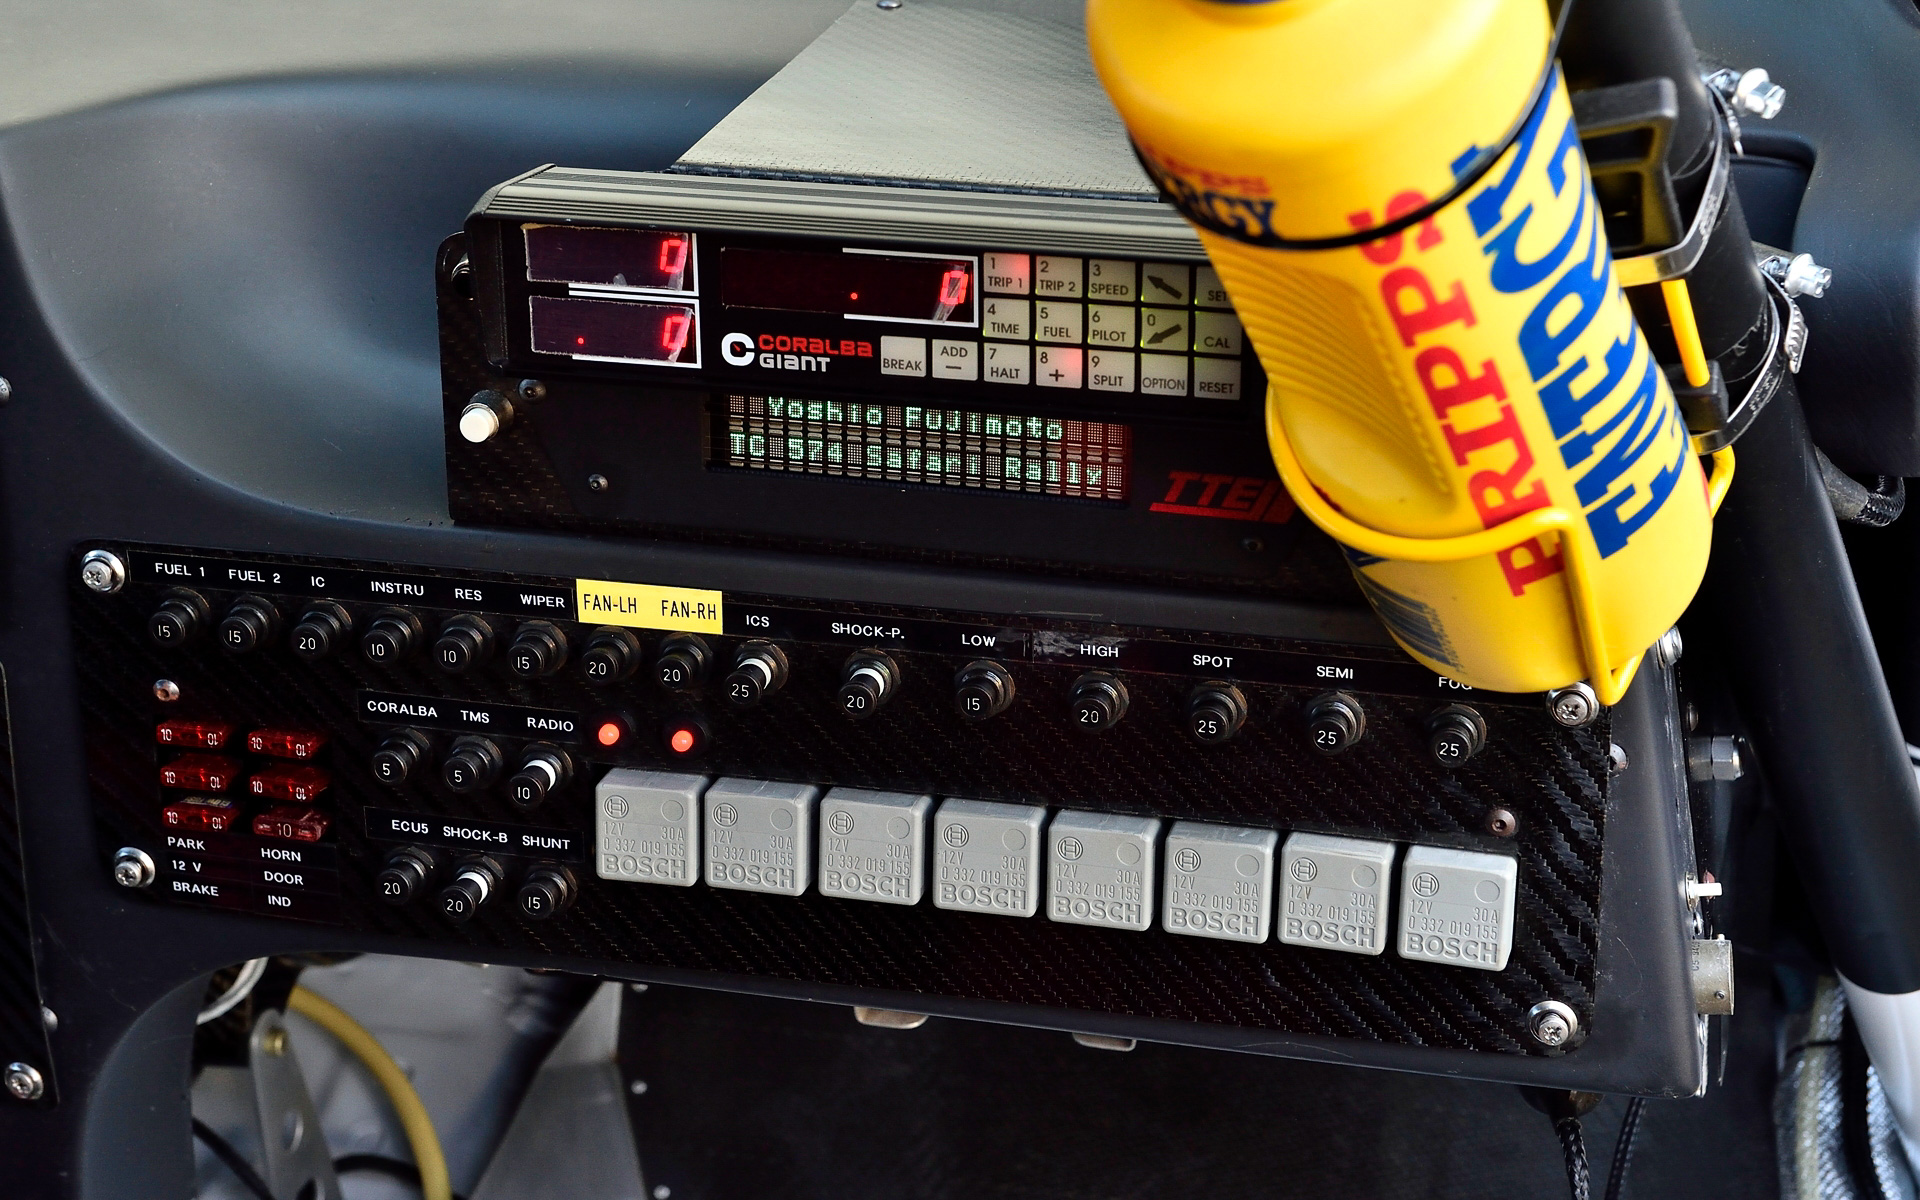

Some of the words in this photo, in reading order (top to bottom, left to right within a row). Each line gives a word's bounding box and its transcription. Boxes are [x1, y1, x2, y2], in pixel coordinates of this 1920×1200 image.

[660, 240, 685, 272] 0
[990, 257, 995, 269] 1
[1040, 261, 1049, 272] 2
[1093, 264, 1101, 276] 3
[988, 276, 1013, 288] TRIP
[1018, 278, 1022, 289] 1
[1040, 279, 1066, 291] TRIP
[1068, 281, 1076, 292] 2
[1091, 283, 1129, 296] SPEED
[1208, 290, 1228, 301] SET
[987, 304, 996, 316] 4
[1040, 308, 1048, 319] 5
[1092, 311, 1100, 323] 6
[1147, 314, 1156, 326] 0
[991, 322, 1020, 334] TIME
[1044, 326, 1071, 338] FUEL
[1092, 330, 1126, 342] PILOT
[1204, 336, 1230, 349] CAL
[759, 334, 873, 357] CORALBA
[940, 346, 968, 358] ADD
[989, 348, 997, 360] 7
[1040, 352, 1048, 364] 8
[759, 353, 830, 372] GIANT
[882, 358, 922, 372] BREAK
[1092, 356, 1100, 368] 9
[991, 367, 1020, 379] HALT
[1094, 374, 1124, 387] SPLIT
[1142, 377, 1186, 390] OPTION
[1200, 382, 1234, 394] RESET
[1347, 189, 1564, 597] PRIPPS
[768, 396, 882, 425] Yoshio
[906, 406, 1062, 440] Fujimoto
[788, 438, 843, 463] 574
[866, 444, 976, 475] Safari
[1005, 456, 1102, 486] Rally
[155, 562, 191, 576] FUEL
[200, 567, 204, 576] 1
[228, 570, 265, 582] FUEL
[273, 573, 281, 584] 2
[311, 576, 325, 588] IC
[370, 581, 424, 596] INSTRU
[454, 588, 482, 602] RES
[520, 594, 566, 608] WIPER
[584, 594, 637, 614] FAN-LH
[661, 600, 717, 620] FAN-RH
[746, 614, 770, 628] ICS
[158, 624, 170, 638] 15
[228, 630, 241, 643] 15
[831, 622, 905, 640] SHOCK-P.
[300, 638, 316, 650] 20
[961, 634, 996, 648] LOW
[372, 644, 384, 656] 10
[443, 650, 456, 663] 10
[1080, 644, 1119, 658] HIGH
[517, 656, 530, 670] 15
[1192, 654, 1233, 668] SPOT
[589, 662, 607, 676] 20
[663, 668, 681, 682] 20
[1316, 666, 1354, 680] SEMI
[732, 684, 750, 698] 25
[367, 700, 438, 718] CORALBA
[846, 696, 865, 710] 20
[966, 698, 980, 712] 15
[460, 710, 490, 724] TMS
[1080, 710, 1099, 724] 20
[527, 718, 574, 732] RADIO
[1198, 720, 1217, 734] 25
[160, 728, 172, 741] 10
[1318, 730, 1336, 744] 25
[252, 737, 262, 750] 10
[1440, 742, 1460, 757] 25
[382, 764, 390, 776] 5
[454, 770, 462, 782] 5
[164, 772, 176, 784] 10
[252, 781, 262, 793] 10
[518, 786, 530, 800] 10
[166, 812, 178, 824] 10
[277, 824, 292, 838] 10
[392, 820, 428, 834] ECU5
[443, 826, 508, 843] SHOCK-B
[168, 836, 206, 850] PARK
[522, 836, 570, 850] SHUNT
[615, 839, 635, 852] 332
[641, 842, 660, 854] 019
[665, 844, 684, 856] 155
[261, 848, 302, 862] HORN
[724, 847, 744, 860] 332
[750, 850, 769, 862] 019
[774, 852, 793, 866] 155
[172, 860, 186, 870] 12
[192, 863, 202, 872] V
[602, 854, 686, 879] BOSCH
[839, 856, 860, 869] 332
[866, 858, 885, 871] 019
[890, 860, 909, 875] 155
[264, 870, 304, 885] DOOR
[711, 862, 794, 888] BOSCH
[954, 868, 975, 882] 332
[981, 871, 1000, 884] 019
[1005, 873, 1025, 887] 155
[172, 882, 219, 896] BRAKE
[384, 882, 400, 894] 20
[825, 870, 910, 898] BOSCH
[1068, 882, 1088, 896] 332
[1096, 885, 1115, 898] 019
[1120, 887, 1139, 900] 155
[268, 895, 291, 907] IND
[528, 896, 541, 910] 15
[941, 883, 1026, 910] BOSCH
[1185, 894, 1205, 907] 332
[1212, 896, 1232, 909] 019
[1237, 898, 1258, 912] 155
[446, 900, 464, 912] 20
[1054, 896, 1140, 923] BOSCH
[1300, 904, 1322, 918] 332
[1329, 906, 1349, 920] 019
[1354, 909, 1374, 924] 155
[1170, 908, 1258, 936] BOSCH
[1421, 918, 1443, 932] 332
[1450, 922, 1470, 936] 019
[1475, 924, 1497, 940] 155
[1286, 918, 1375, 948] BOSCH
[1406, 933, 1497, 964] BOSCH
